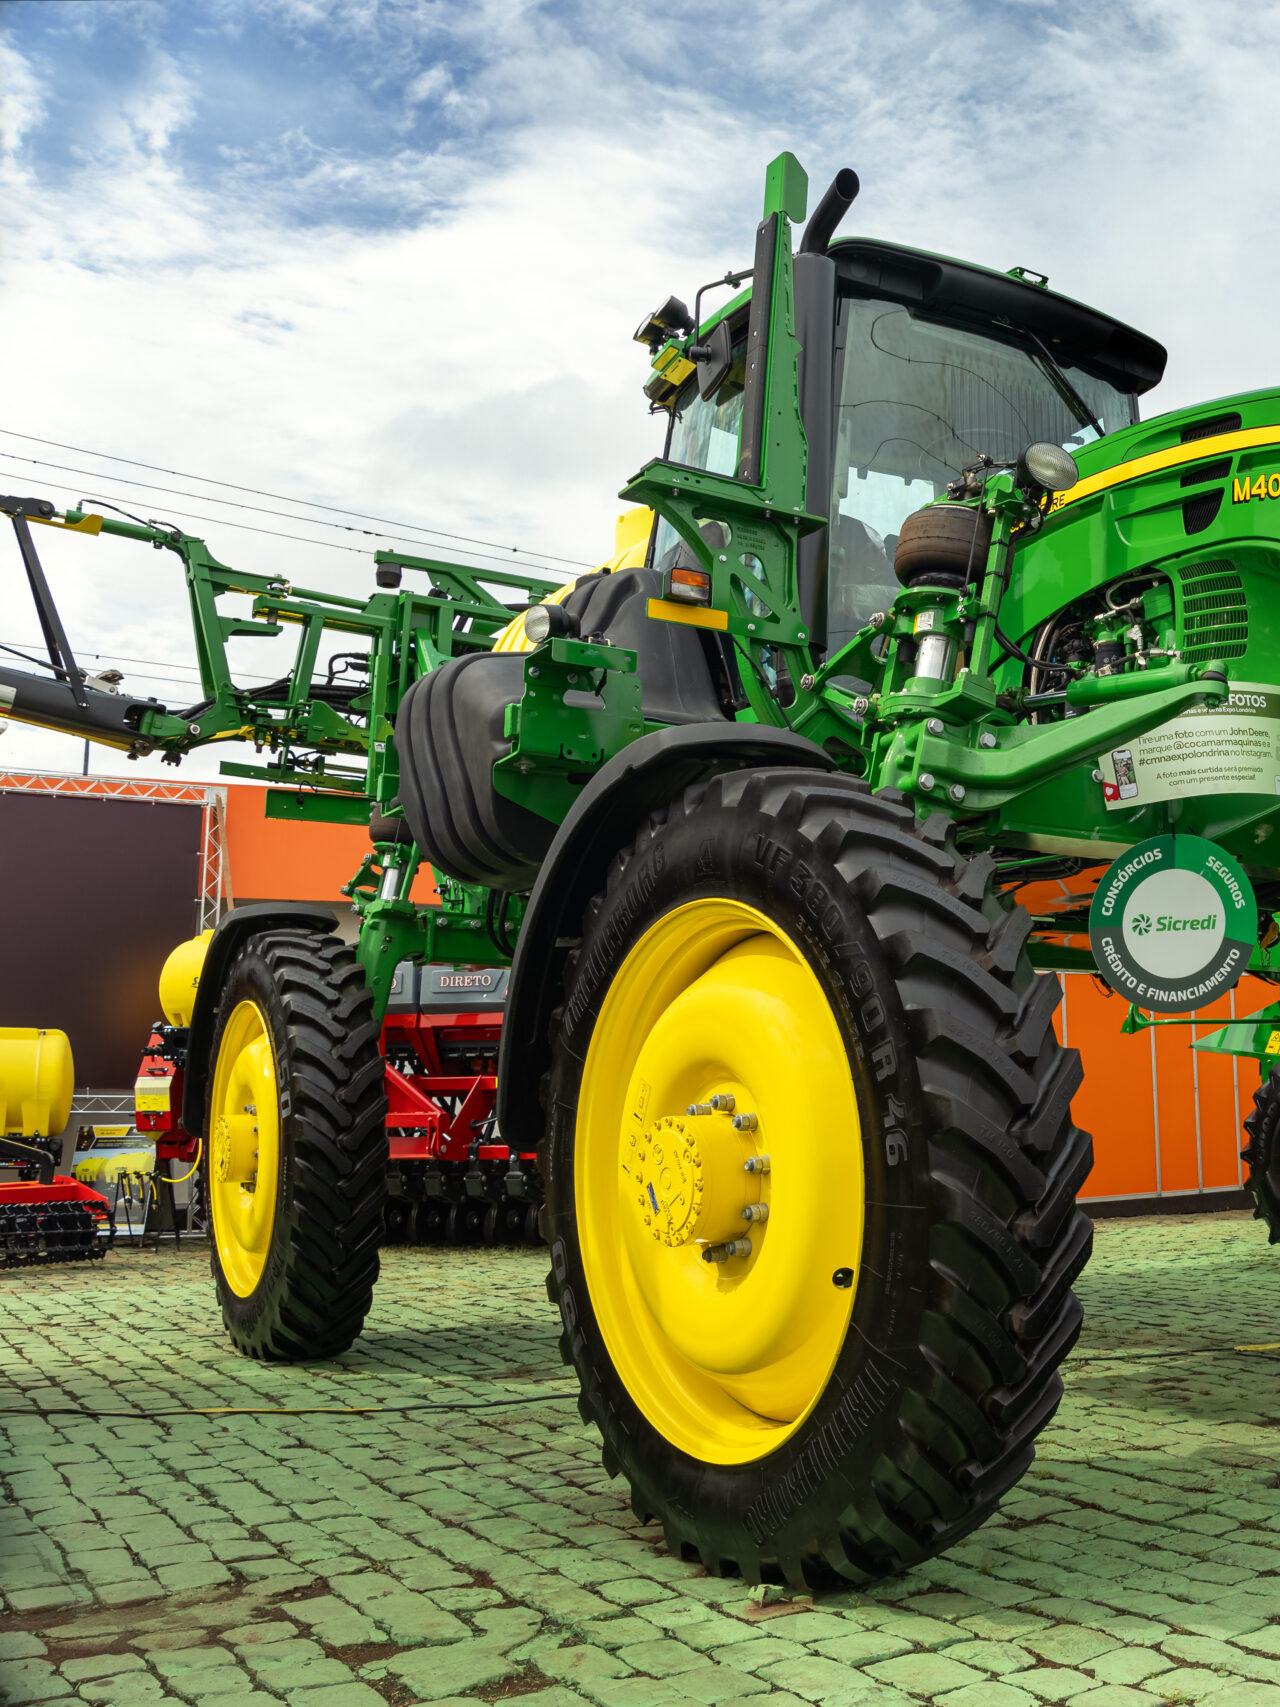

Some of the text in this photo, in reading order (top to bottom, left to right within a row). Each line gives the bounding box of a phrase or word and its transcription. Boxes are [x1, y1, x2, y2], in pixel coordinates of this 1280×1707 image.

[1229, 693, 1267, 708] FOTOS
[1222, 706, 1236, 714] Expo
[1138, 727, 1271, 745] Tire uma foto com um John Deere,
[1139, 744, 1172, 756] marque
[1173, 738, 1262, 750] @cocamarmaquinas
[1138, 748, 1230, 767] #cmnaexpolondrina
[1230, 749, 1240, 757] no
[1156, 772, 1162, 780] A
[1163, 771, 1178, 779] foto
[1178, 768, 1197, 777] mais
[1197, 766, 1223, 775] curtida
[1168, 779, 1185, 787] com
[1198, 774, 1230, 785] presente
[1101, 847, 1163, 917] CONSÓRCIOS
[1205, 855, 1246, 910] SEGUROS
[1155, 914, 1217, 932] Sicredi
[1101, 936, 1241, 1003] CRÉDITO E FINANCIAMENTO
[439, 974, 492, 988] DIRETO
[871, 1037, 897, 1082] R
[881, 1093, 911, 1167] 46
